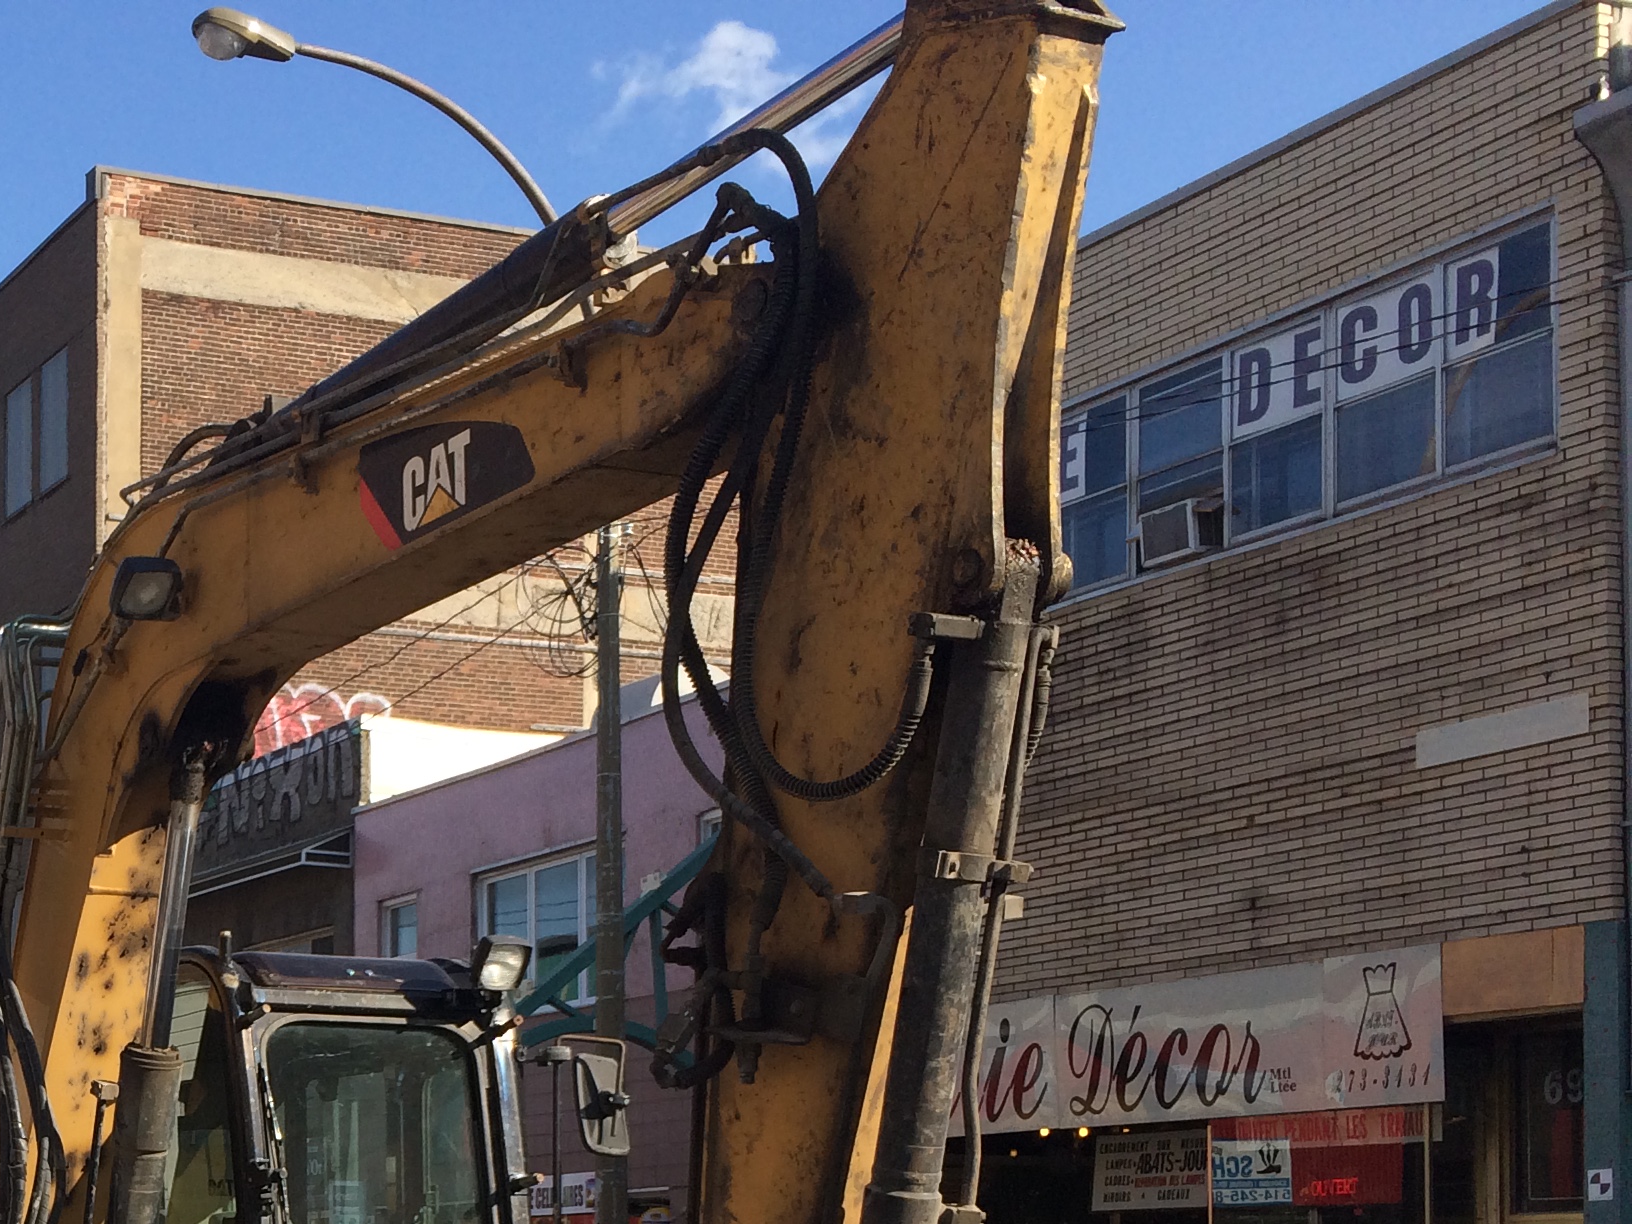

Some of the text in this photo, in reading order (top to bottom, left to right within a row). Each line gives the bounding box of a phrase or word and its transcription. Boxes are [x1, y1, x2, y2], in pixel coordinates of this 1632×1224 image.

[1237, 258, 1495, 427] DECOR
[403, 428, 471, 532] CAT
[952, 1003, 1266, 1123] ie Décor
[1270, 1067, 1291, 1081] Mtl
[1270, 1079, 1297, 1093] Ltée
[1346, 1112, 1367, 1140] LES
[1380, 1110, 1426, 1138] TRAVAU
[1181, 1137, 1207, 1150] MESUR
[1311, 1177, 1359, 1197] OUVERT
